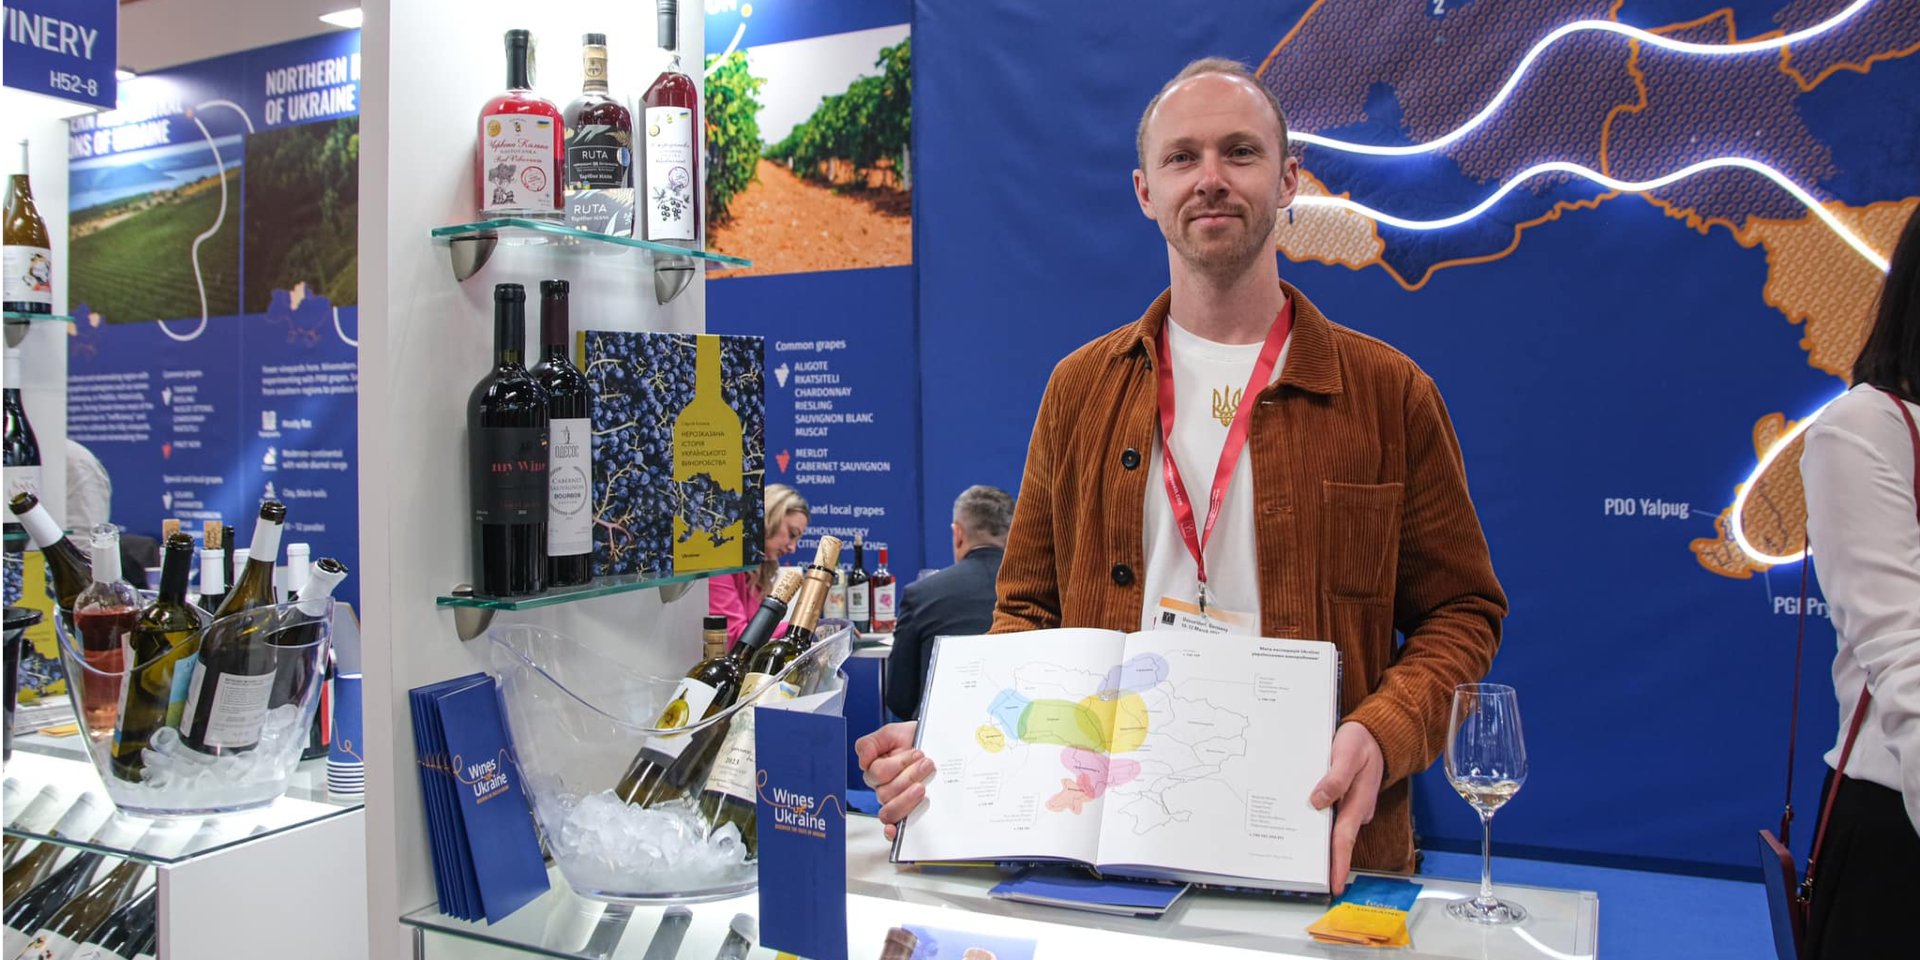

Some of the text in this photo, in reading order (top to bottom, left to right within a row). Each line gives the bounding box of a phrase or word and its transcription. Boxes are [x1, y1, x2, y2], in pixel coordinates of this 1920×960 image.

[266, 55, 347, 96] NORTHERN
[50, 70, 98, 97] H52-8
[265, 83, 356, 125] OF UKRAINE
[582, 150, 608, 159] RUTA
[574, 203, 607, 214] RUTA
[1286, 208, 1293, 224] 1
[775, 340, 847, 352] Common grapes
[794, 361, 828, 371] ALIGOTE
[794, 374, 840, 384] RKATSITELI
[794, 387, 852, 397] CHARDONNAY
[795, 400, 833, 410] RIESLING
[795, 413, 874, 424] SAUVIGNON BLANC
[795, 427, 828, 436] MUSCAT
[795, 448, 828, 458] MERLOT
[795, 461, 891, 472] CABERNET SAUVIGNON
[796, 475, 835, 484] SAPERAVI
[810, 504, 885, 517] and local grapes
[1604, 498, 1690, 519] PDO Yalpug
[1773, 596, 1801, 615] PGI
[468, 759, 497, 780] Wines
[473, 773, 508, 797] Ukraine
[773, 787, 815, 809] Wines
[775, 807, 826, 831] Ukraine
